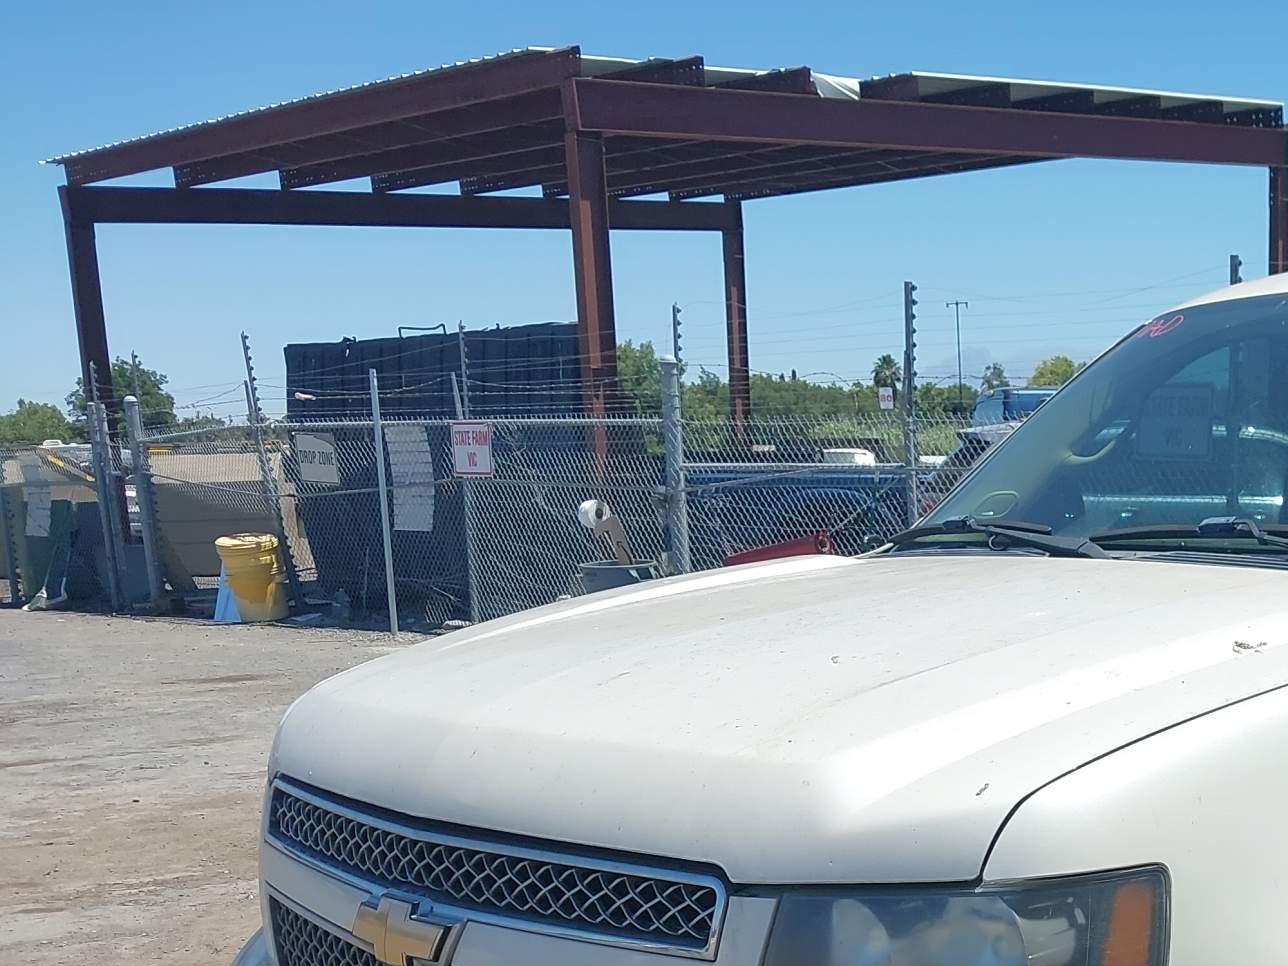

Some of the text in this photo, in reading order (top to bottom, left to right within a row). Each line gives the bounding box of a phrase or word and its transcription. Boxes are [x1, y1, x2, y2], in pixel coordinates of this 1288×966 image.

[454, 430, 489, 446] STATE FARM
[299, 449, 335, 466] DROP ZONE
